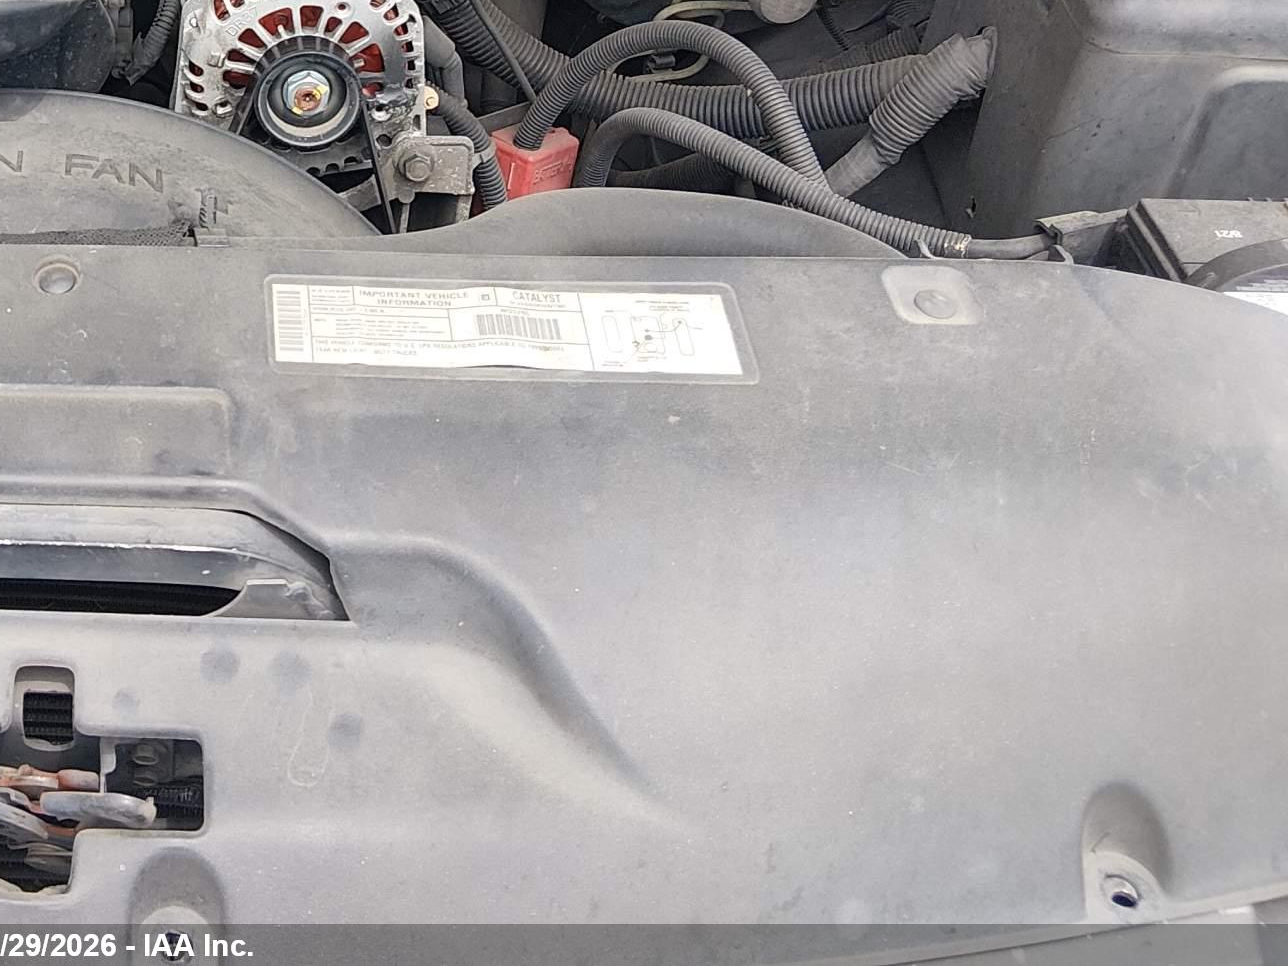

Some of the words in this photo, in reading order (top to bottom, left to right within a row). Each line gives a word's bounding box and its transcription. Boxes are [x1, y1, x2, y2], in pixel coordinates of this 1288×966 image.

[64, 153, 165, 194] FAN
[359, 290, 421, 300] IMPORTANT
[425, 291, 470, 300] VEHICLE
[512, 291, 561, 304] CATALYST
[377, 299, 452, 307] INFORMATION
